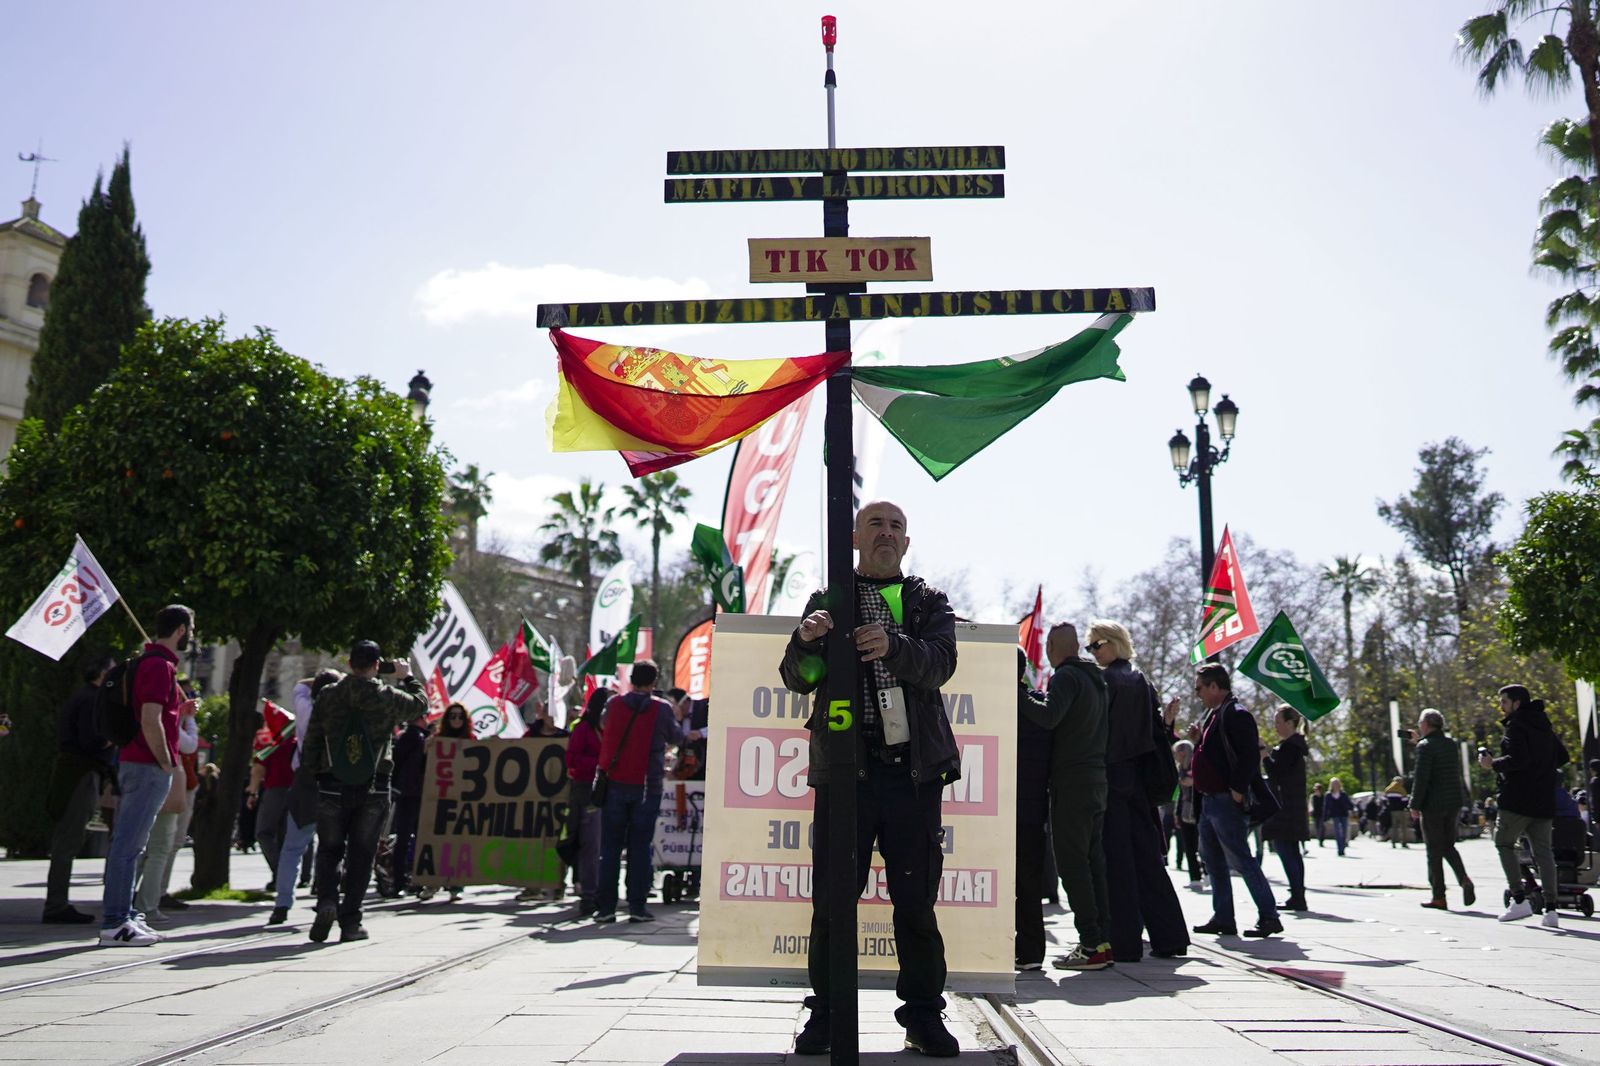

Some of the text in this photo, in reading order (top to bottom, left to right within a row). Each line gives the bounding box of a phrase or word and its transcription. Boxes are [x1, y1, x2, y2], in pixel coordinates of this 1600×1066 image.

[673, 146, 1000, 172] AYUNTAMIENTO DE SEVILLA
[672, 173, 995, 200] MAFIA Y LADRONES
[765, 248, 917, 273] TIK TOK
[734, 408, 800, 567] UGT
[828, 700, 853, 731] 5
[435, 741, 456, 798] UGT
[461, 744, 567, 801] 300
[416, 844, 435, 876] A
[439, 842, 473, 879] LA
